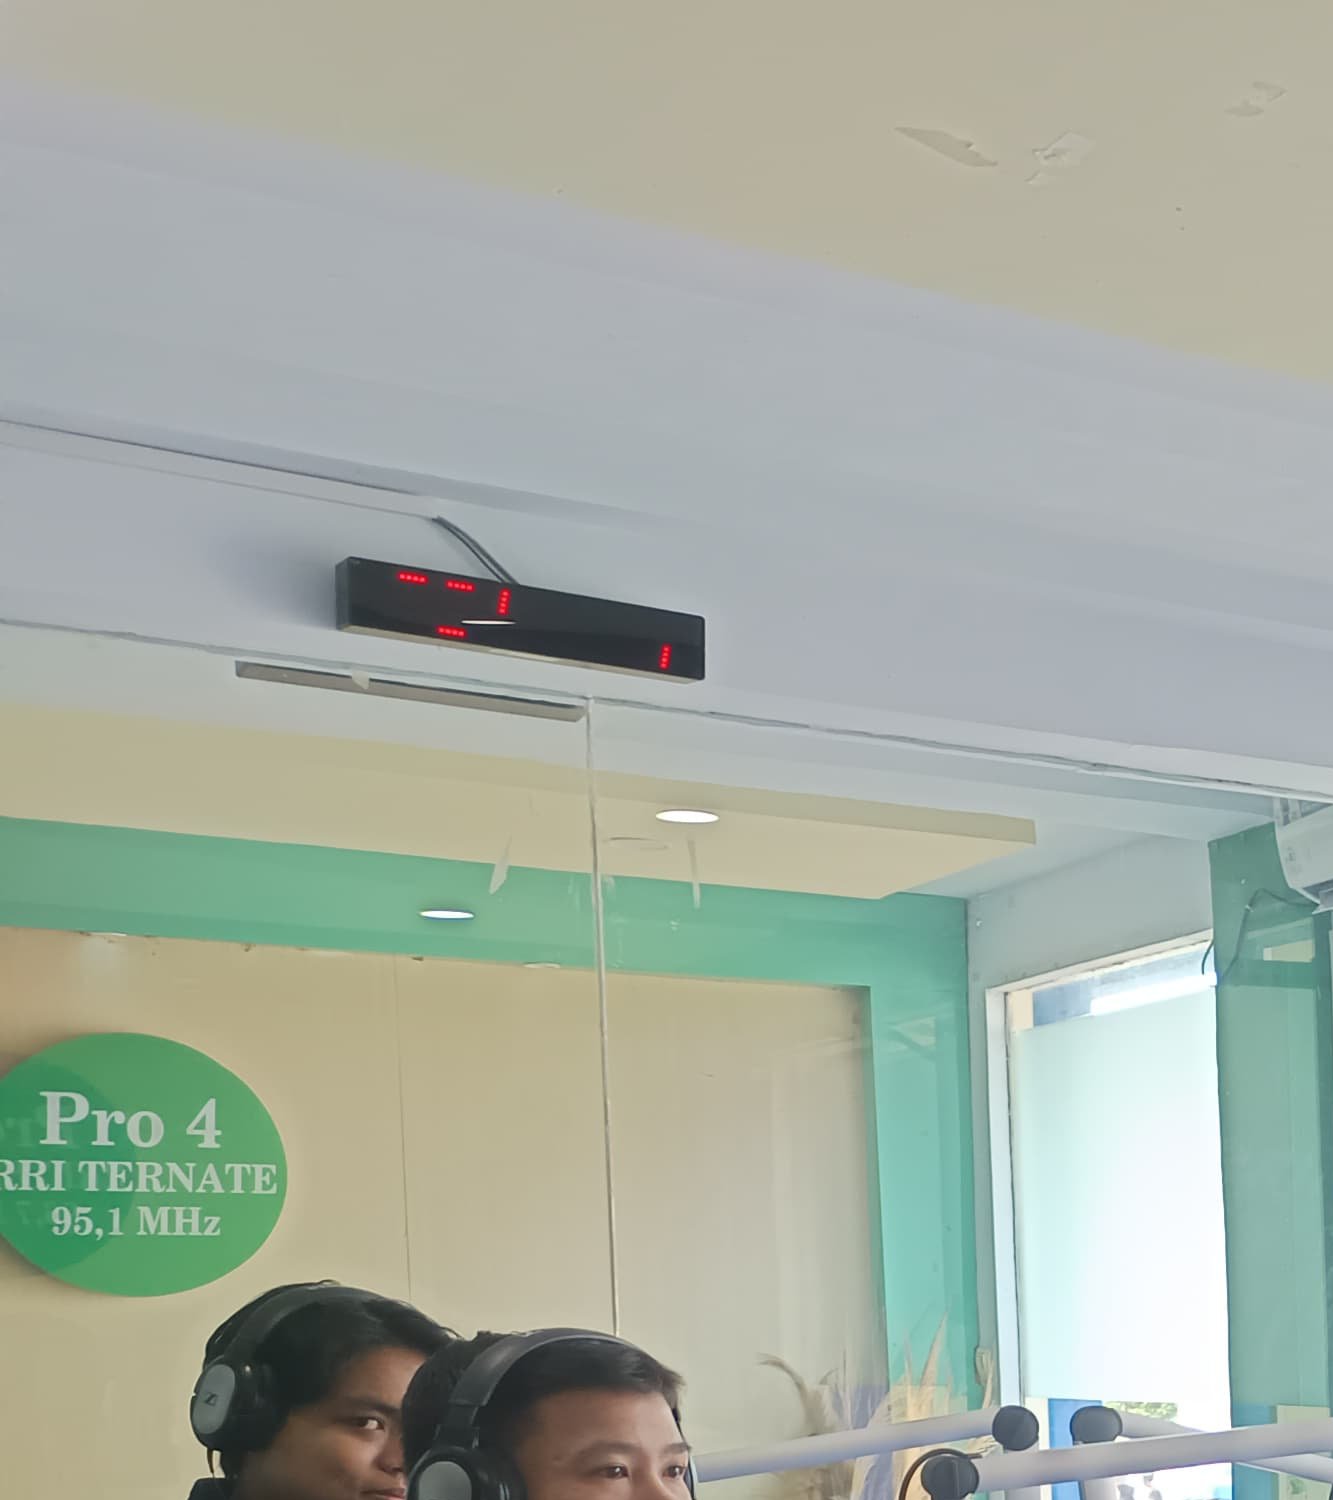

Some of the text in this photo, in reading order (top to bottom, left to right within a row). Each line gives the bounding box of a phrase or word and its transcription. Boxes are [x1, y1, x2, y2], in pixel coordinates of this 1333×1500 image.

[39, 1091, 222, 1149] Pro 4
[78, 1161, 278, 1194] TERNATE
[51, 1206, 221, 1240] 95,1 MHz
